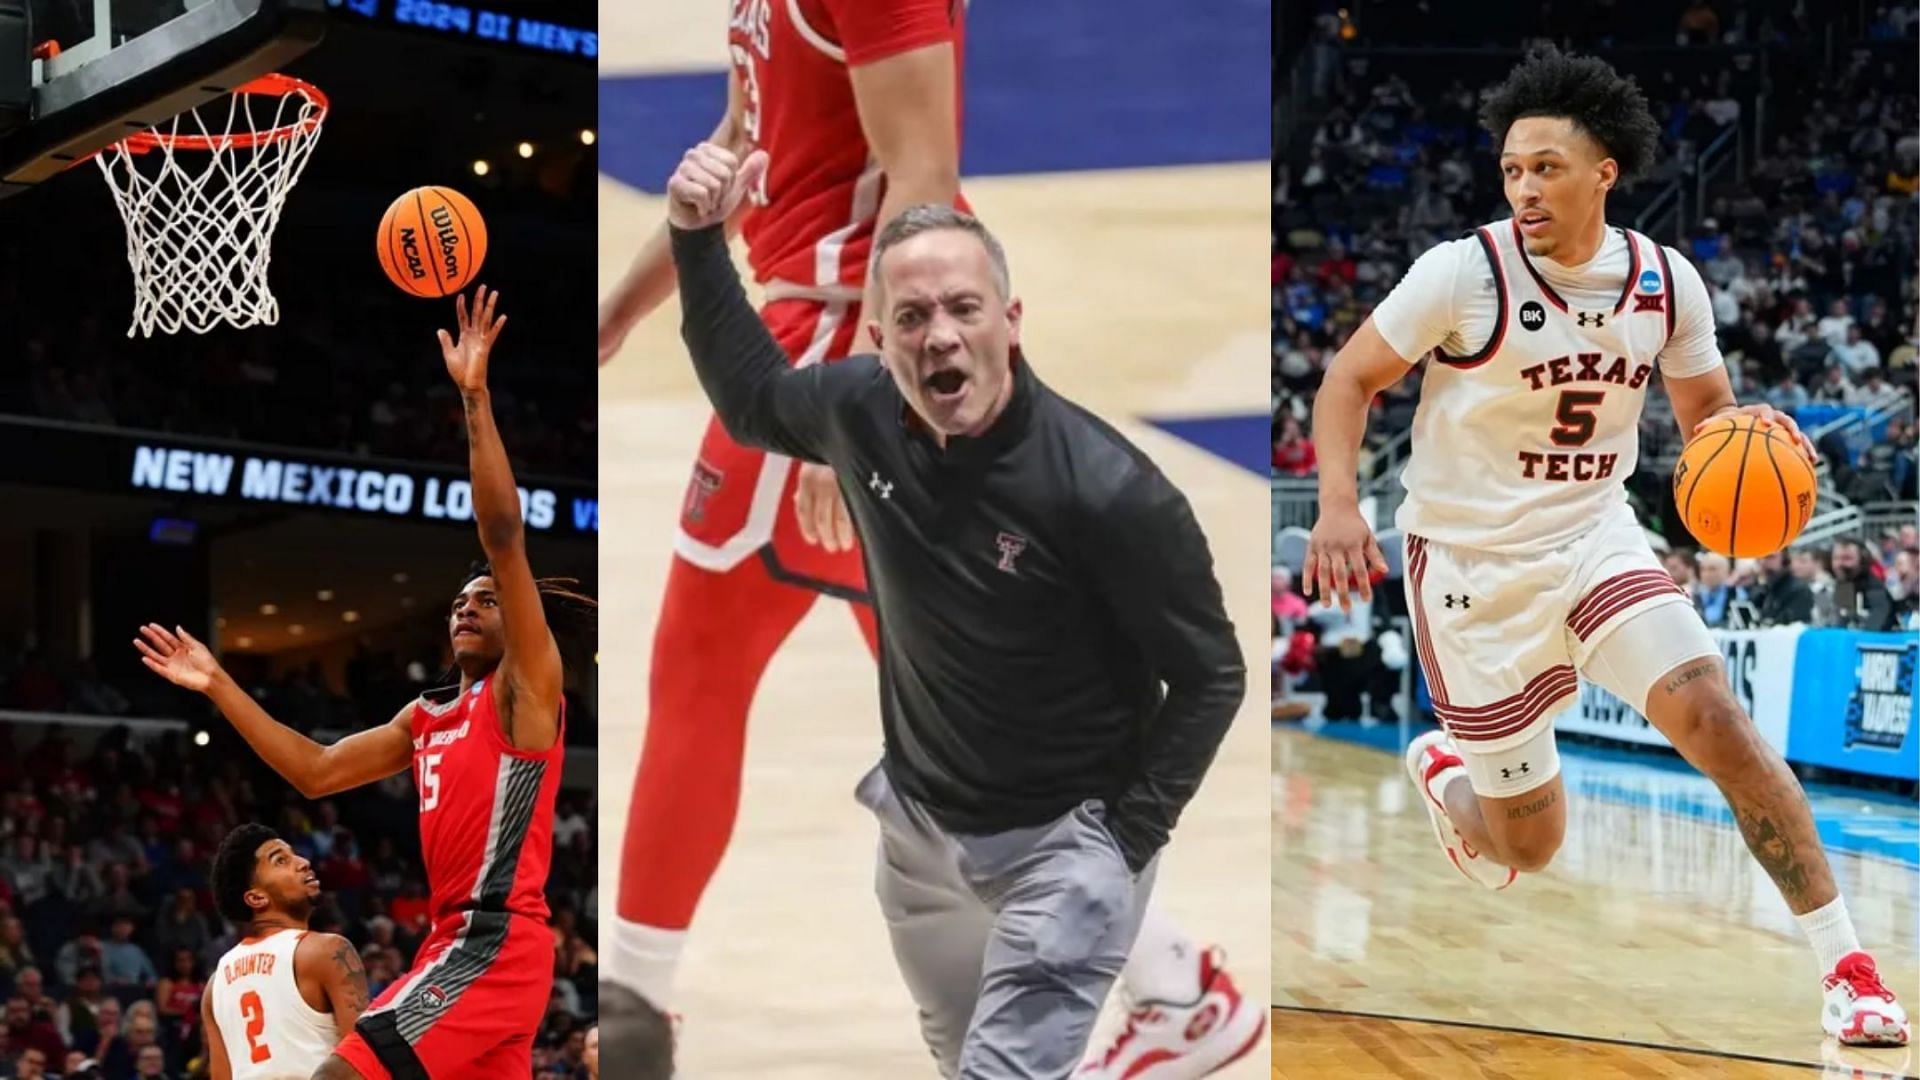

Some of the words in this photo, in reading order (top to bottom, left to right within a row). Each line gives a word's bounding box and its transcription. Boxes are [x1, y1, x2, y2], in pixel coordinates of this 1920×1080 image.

[395, 0, 471, 32] 2024
[516, 18, 598, 57] MEN'S
[400, 227, 427, 280] NCAA
[431, 206, 459, 280] Wilson
[1522, 310, 1542, 322] BK
[1520, 353, 1652, 391] TEXAS
[1550, 390, 1606, 447] 5
[131, 446, 235, 496] NEW
[241, 457, 414, 514] MEXICO
[423, 477, 557, 530] LOS
[573, 498, 598, 532] V
[1518, 451, 1618, 481] TECH
[240, 990, 271, 1064] 2
